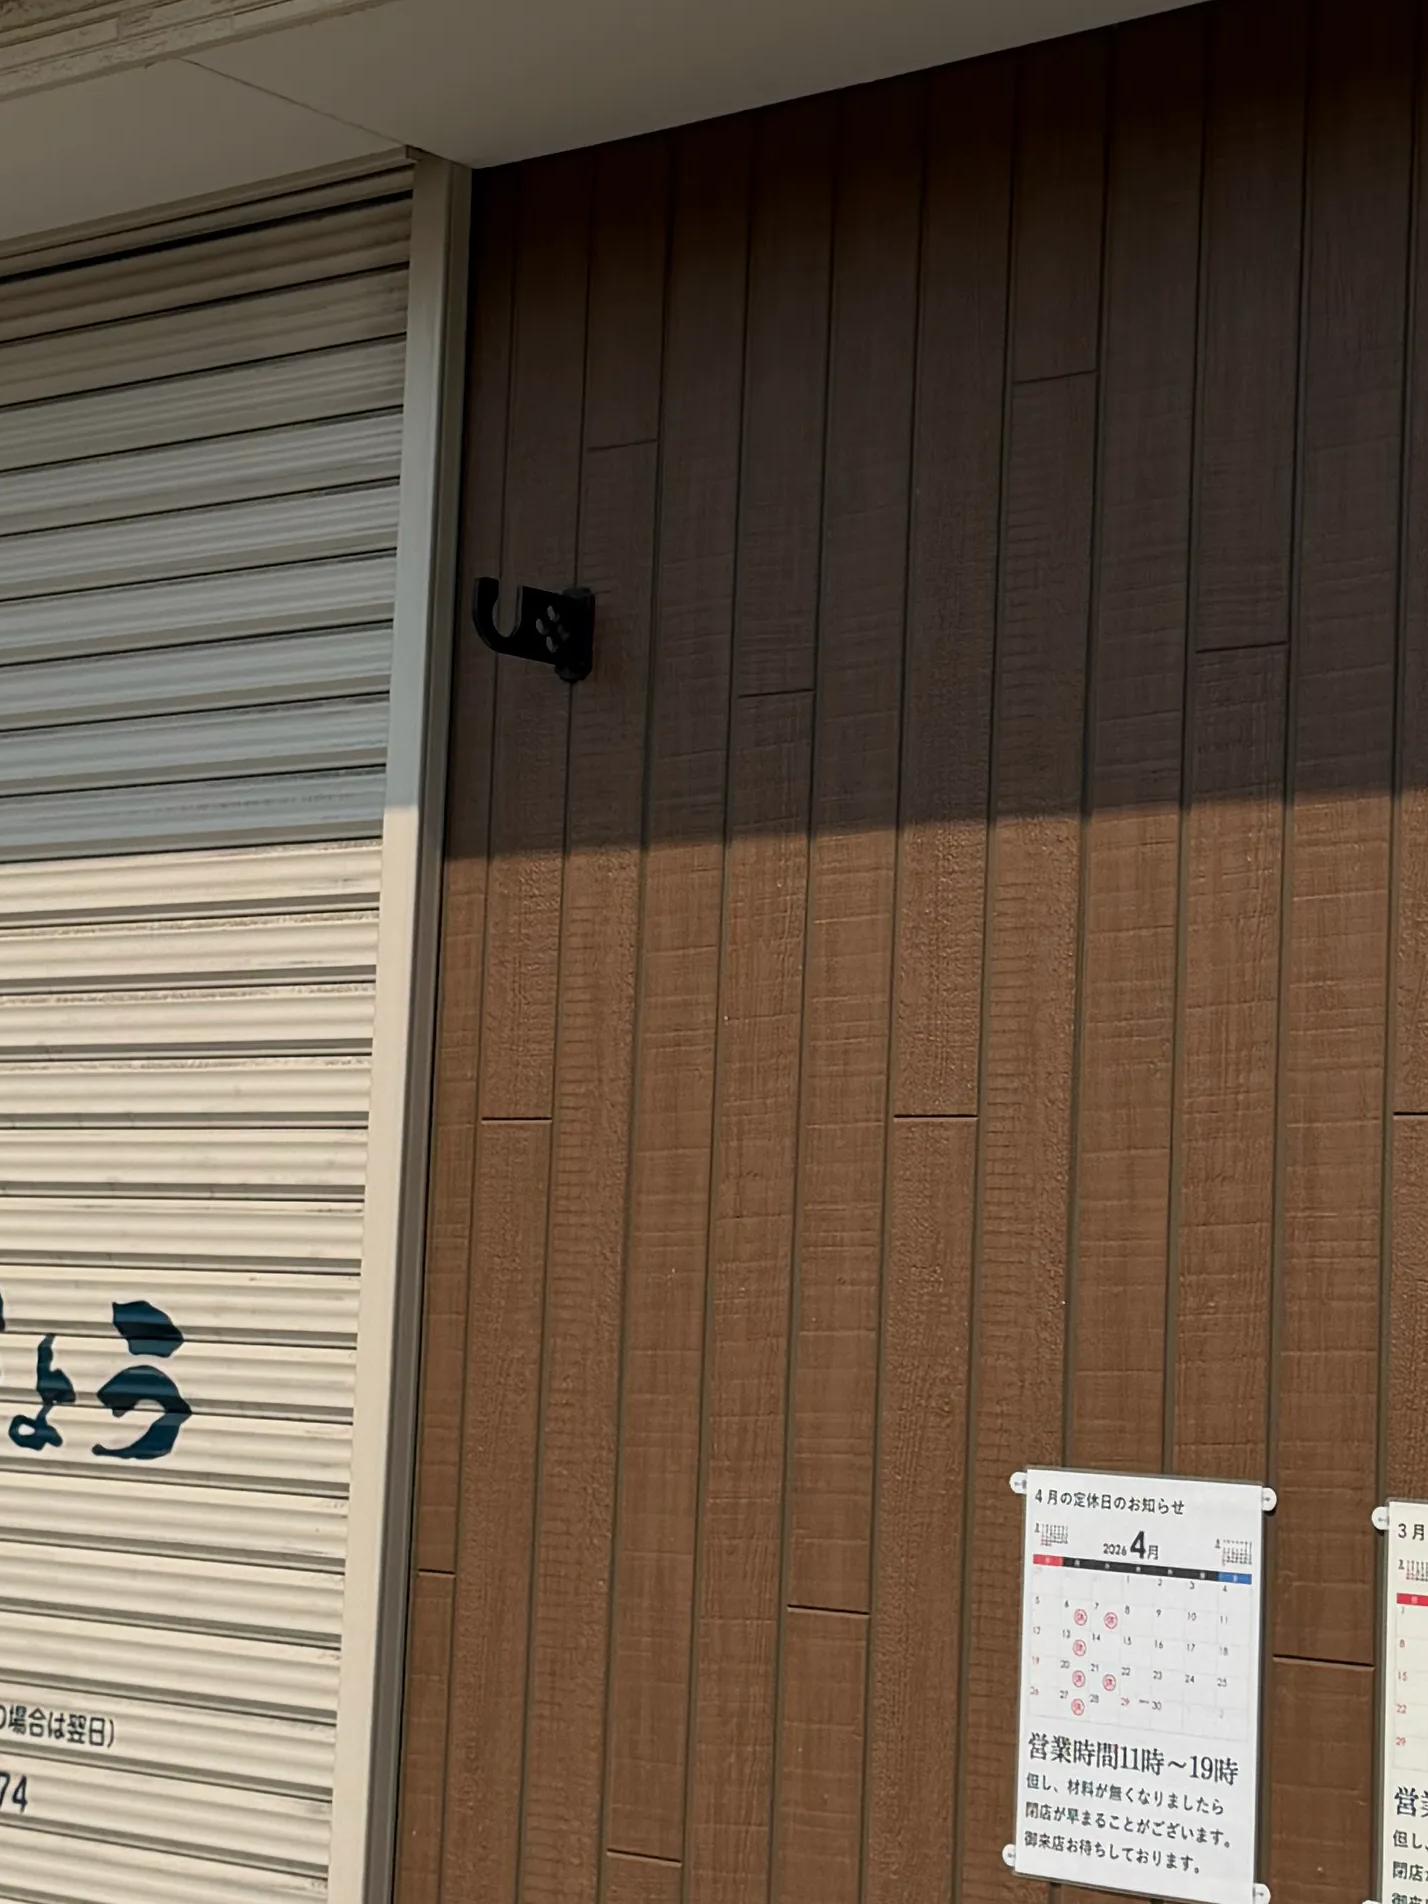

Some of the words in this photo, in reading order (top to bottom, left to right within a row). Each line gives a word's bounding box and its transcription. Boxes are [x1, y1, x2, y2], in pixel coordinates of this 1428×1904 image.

[1035, 1488, 1185, 1515] 4月の定休日のお知らせ
[1130, 1530, 1159, 1560] 4月
[1187, 1612, 1197, 1621] 10
[1092, 1633, 1101, 1641] 14
[1154, 1640, 1163, 1649] 16
[1187, 1643, 1195, 1652] 17
[1091, 1663, 1099, 1672] 21
[1185, 1675, 1195, 1683] 24
[1398, 1672, 1407, 1681] 15
[1060, 1691, 1068, 1699] 27
[1152, 1701, 1162, 1710] 30
[1026, 1772, 1224, 1815] 但し、材料が無くなりましたら
[1025, 1801, 1230, 1848] 閉店が早まることがございます。
[1024, 1830, 1199, 1874] 御来店お待ちしております。
